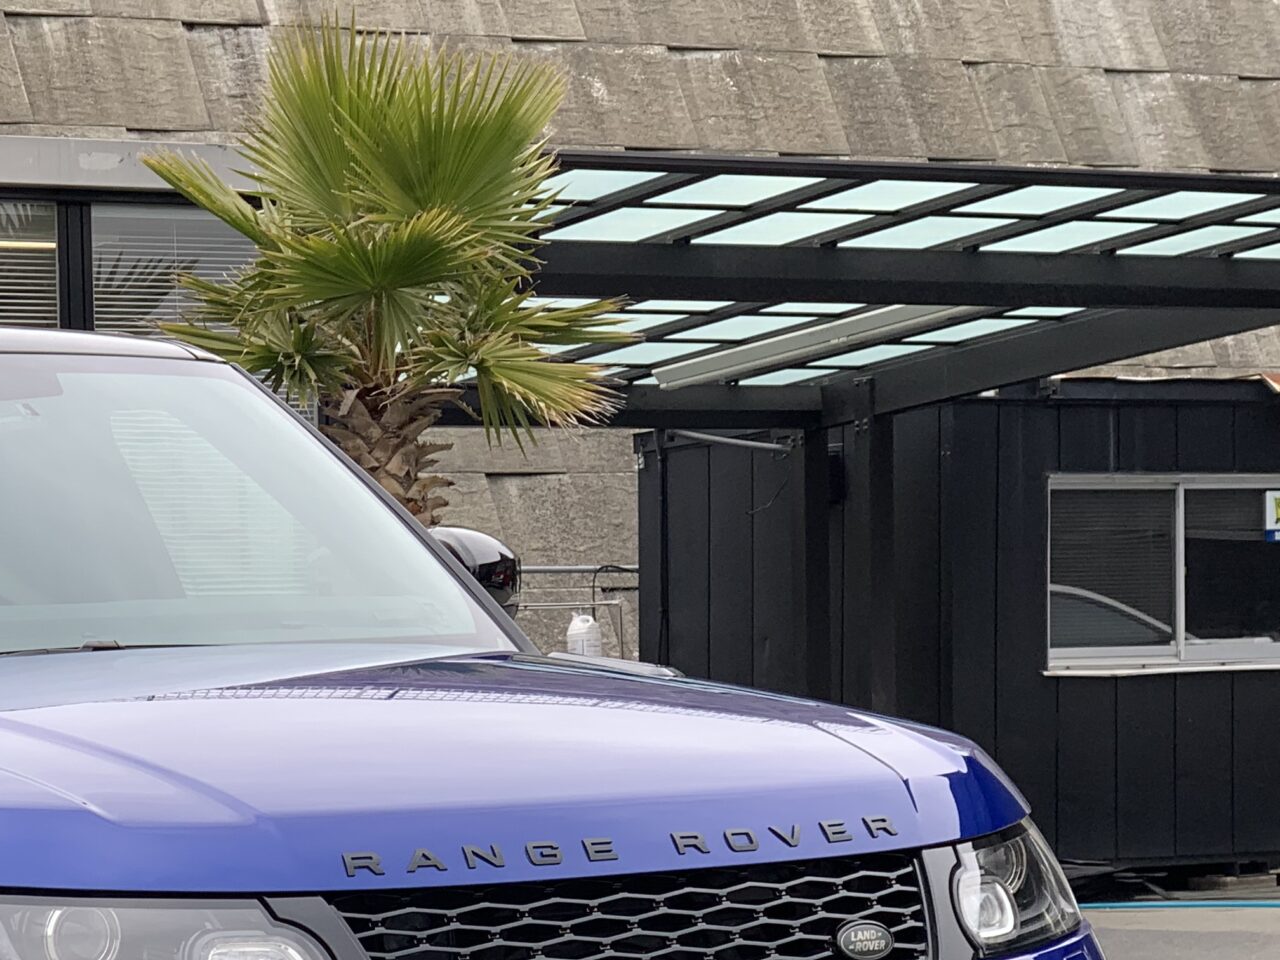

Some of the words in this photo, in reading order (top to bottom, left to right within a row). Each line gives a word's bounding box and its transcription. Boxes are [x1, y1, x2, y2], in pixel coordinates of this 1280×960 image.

[341, 837, 619, 877] RANGE
[670, 815, 898, 855] ROVER
[850, 929, 877, 942] LAND
[854, 939, 886, 952] ROVER
